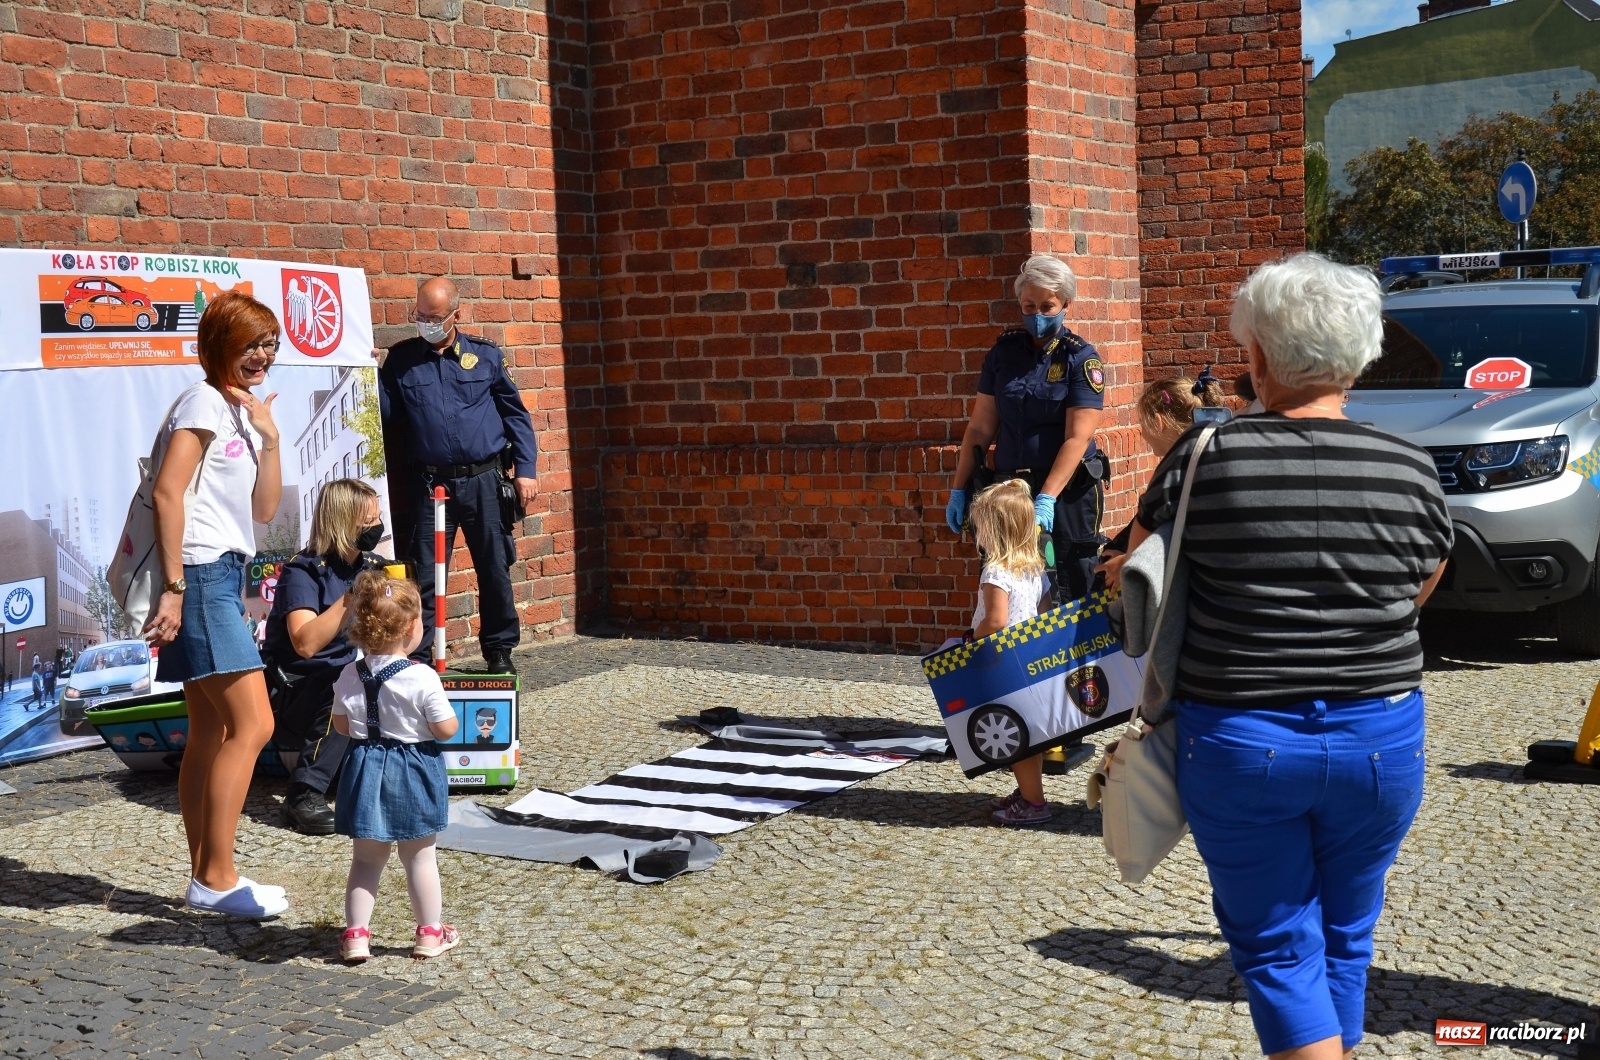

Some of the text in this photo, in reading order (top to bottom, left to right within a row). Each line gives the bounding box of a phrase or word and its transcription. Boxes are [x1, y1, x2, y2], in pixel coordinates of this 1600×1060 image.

[52, 253, 241, 279] KOŁA STOP ROBISZ KROK
[1442, 260, 1496, 268] MIEJSKA
[109, 341, 139, 349] UPEWNIJ
[54, 353, 65, 361] czy
[67, 351, 99, 361] wszystkie
[100, 350, 122, 360] pojazdy
[1474, 371, 1521, 383] STOP
[1027, 648, 1068, 676] STRAŻ
[460, 681, 475, 689] DO
[478, 681, 513, 689] DROGI
